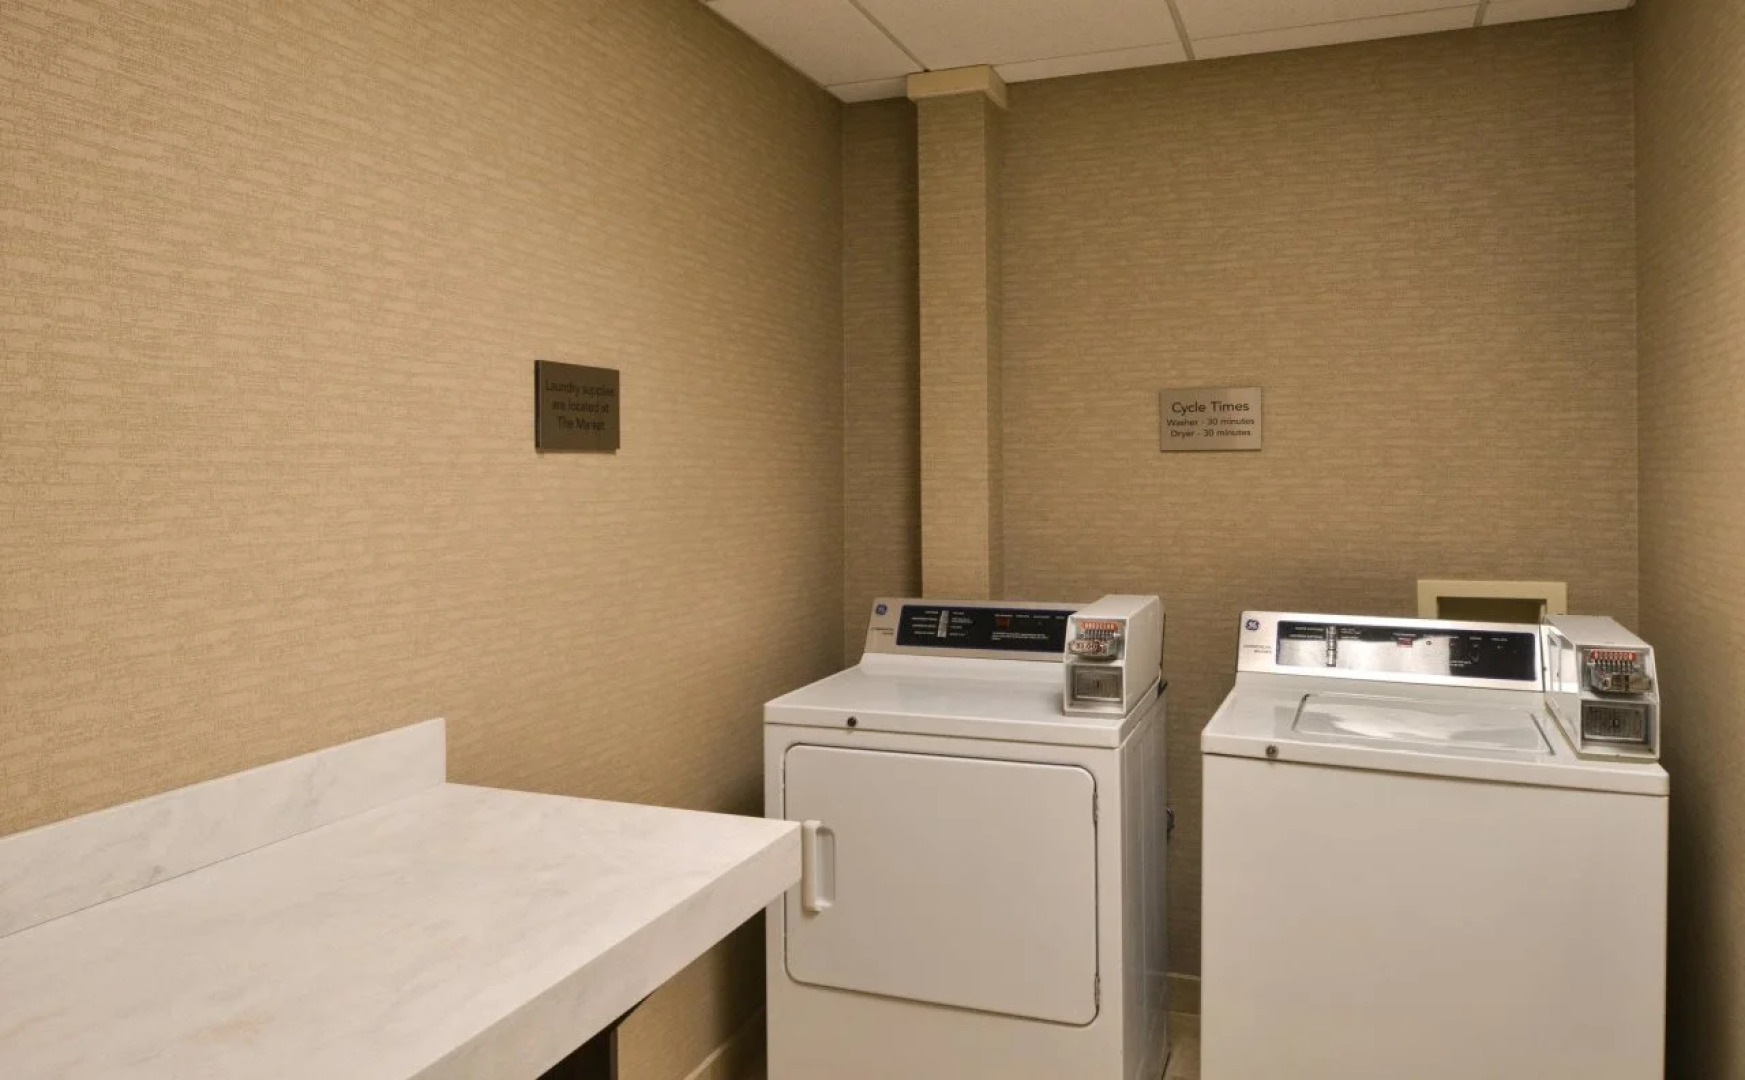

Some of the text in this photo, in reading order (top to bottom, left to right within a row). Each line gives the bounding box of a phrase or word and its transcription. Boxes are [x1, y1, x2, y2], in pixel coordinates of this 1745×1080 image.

[544, 379, 580, 397] Laundry
[568, 398, 600, 413] located
[1171, 400, 1250, 416] Cycle Times
[557, 416, 574, 429] The
[1166, 418, 1198, 427] Washer
[1170, 430, 1195, 439] Dryer
[1203, 429, 1215, 437] 30
[1216, 428, 1251, 436] minutes
